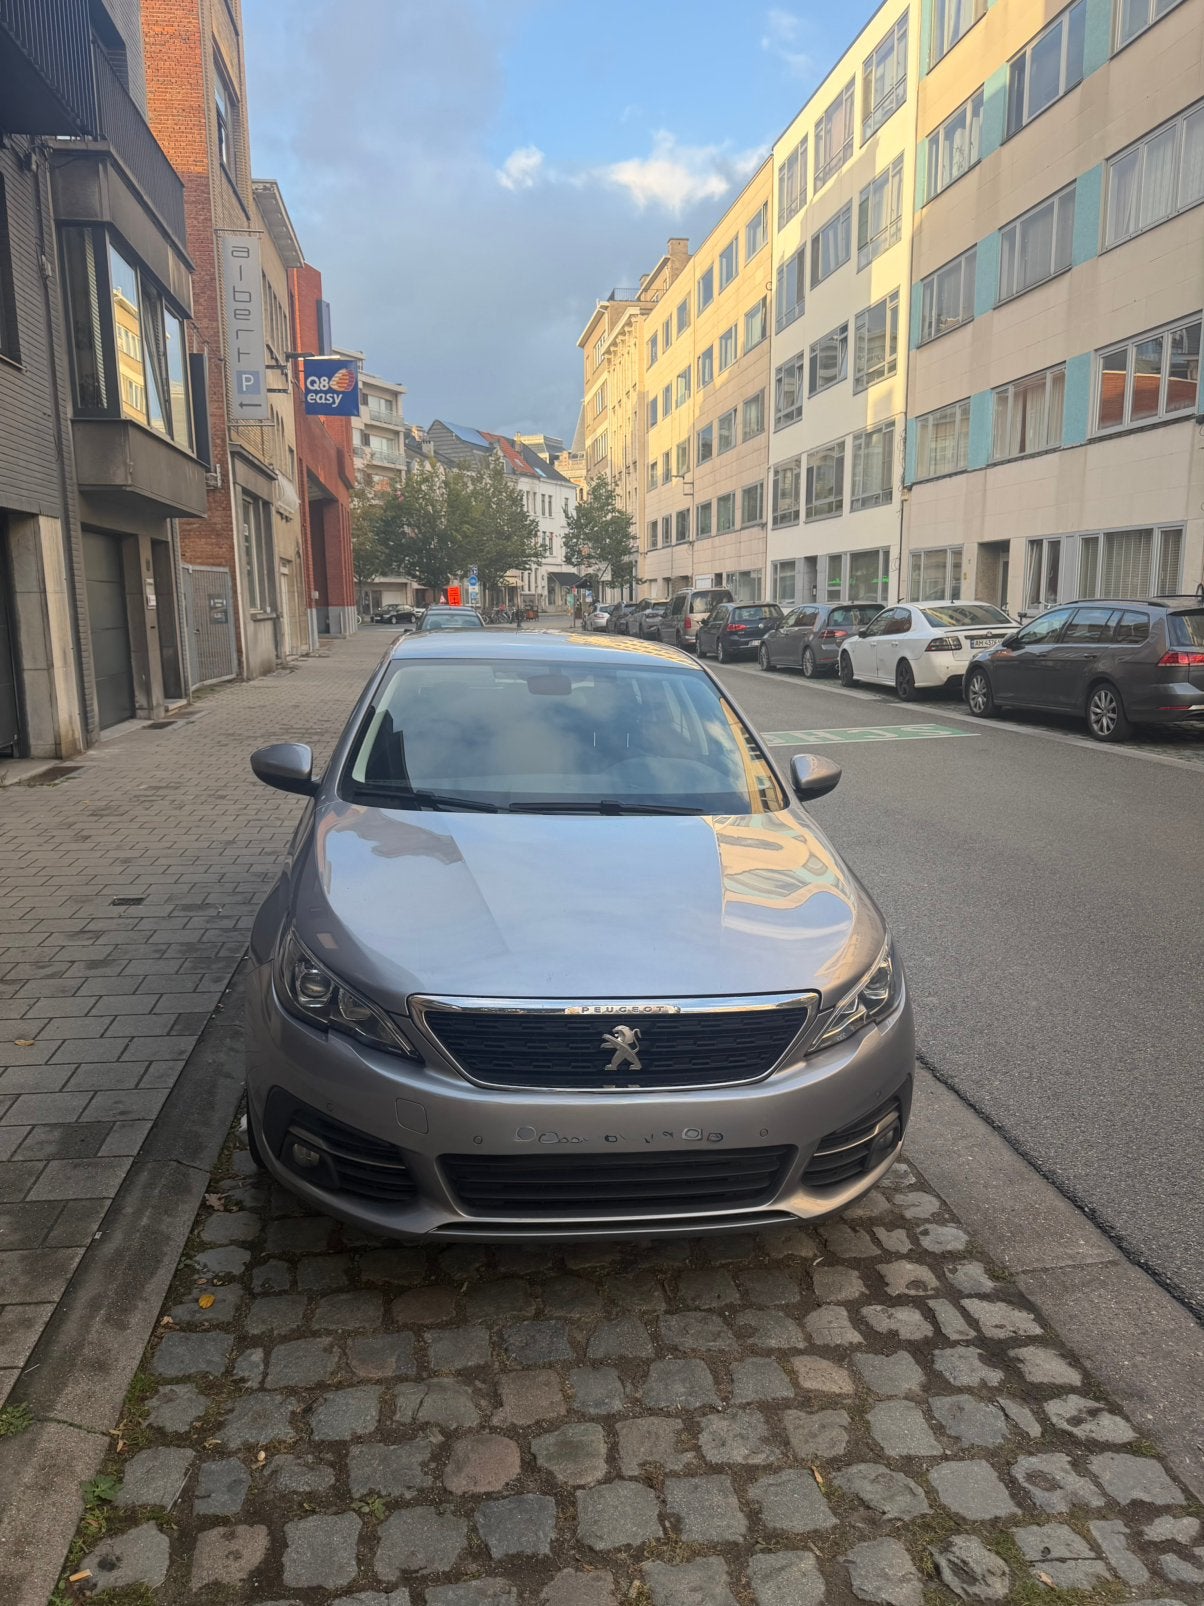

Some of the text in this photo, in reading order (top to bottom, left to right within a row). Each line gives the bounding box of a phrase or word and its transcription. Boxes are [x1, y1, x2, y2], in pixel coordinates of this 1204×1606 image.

[241, 374, 254, 391] P
[306, 376, 329, 391] Q8
[306, 393, 343, 407] easy
[581, 1006, 665, 1014] PEUGEOT
